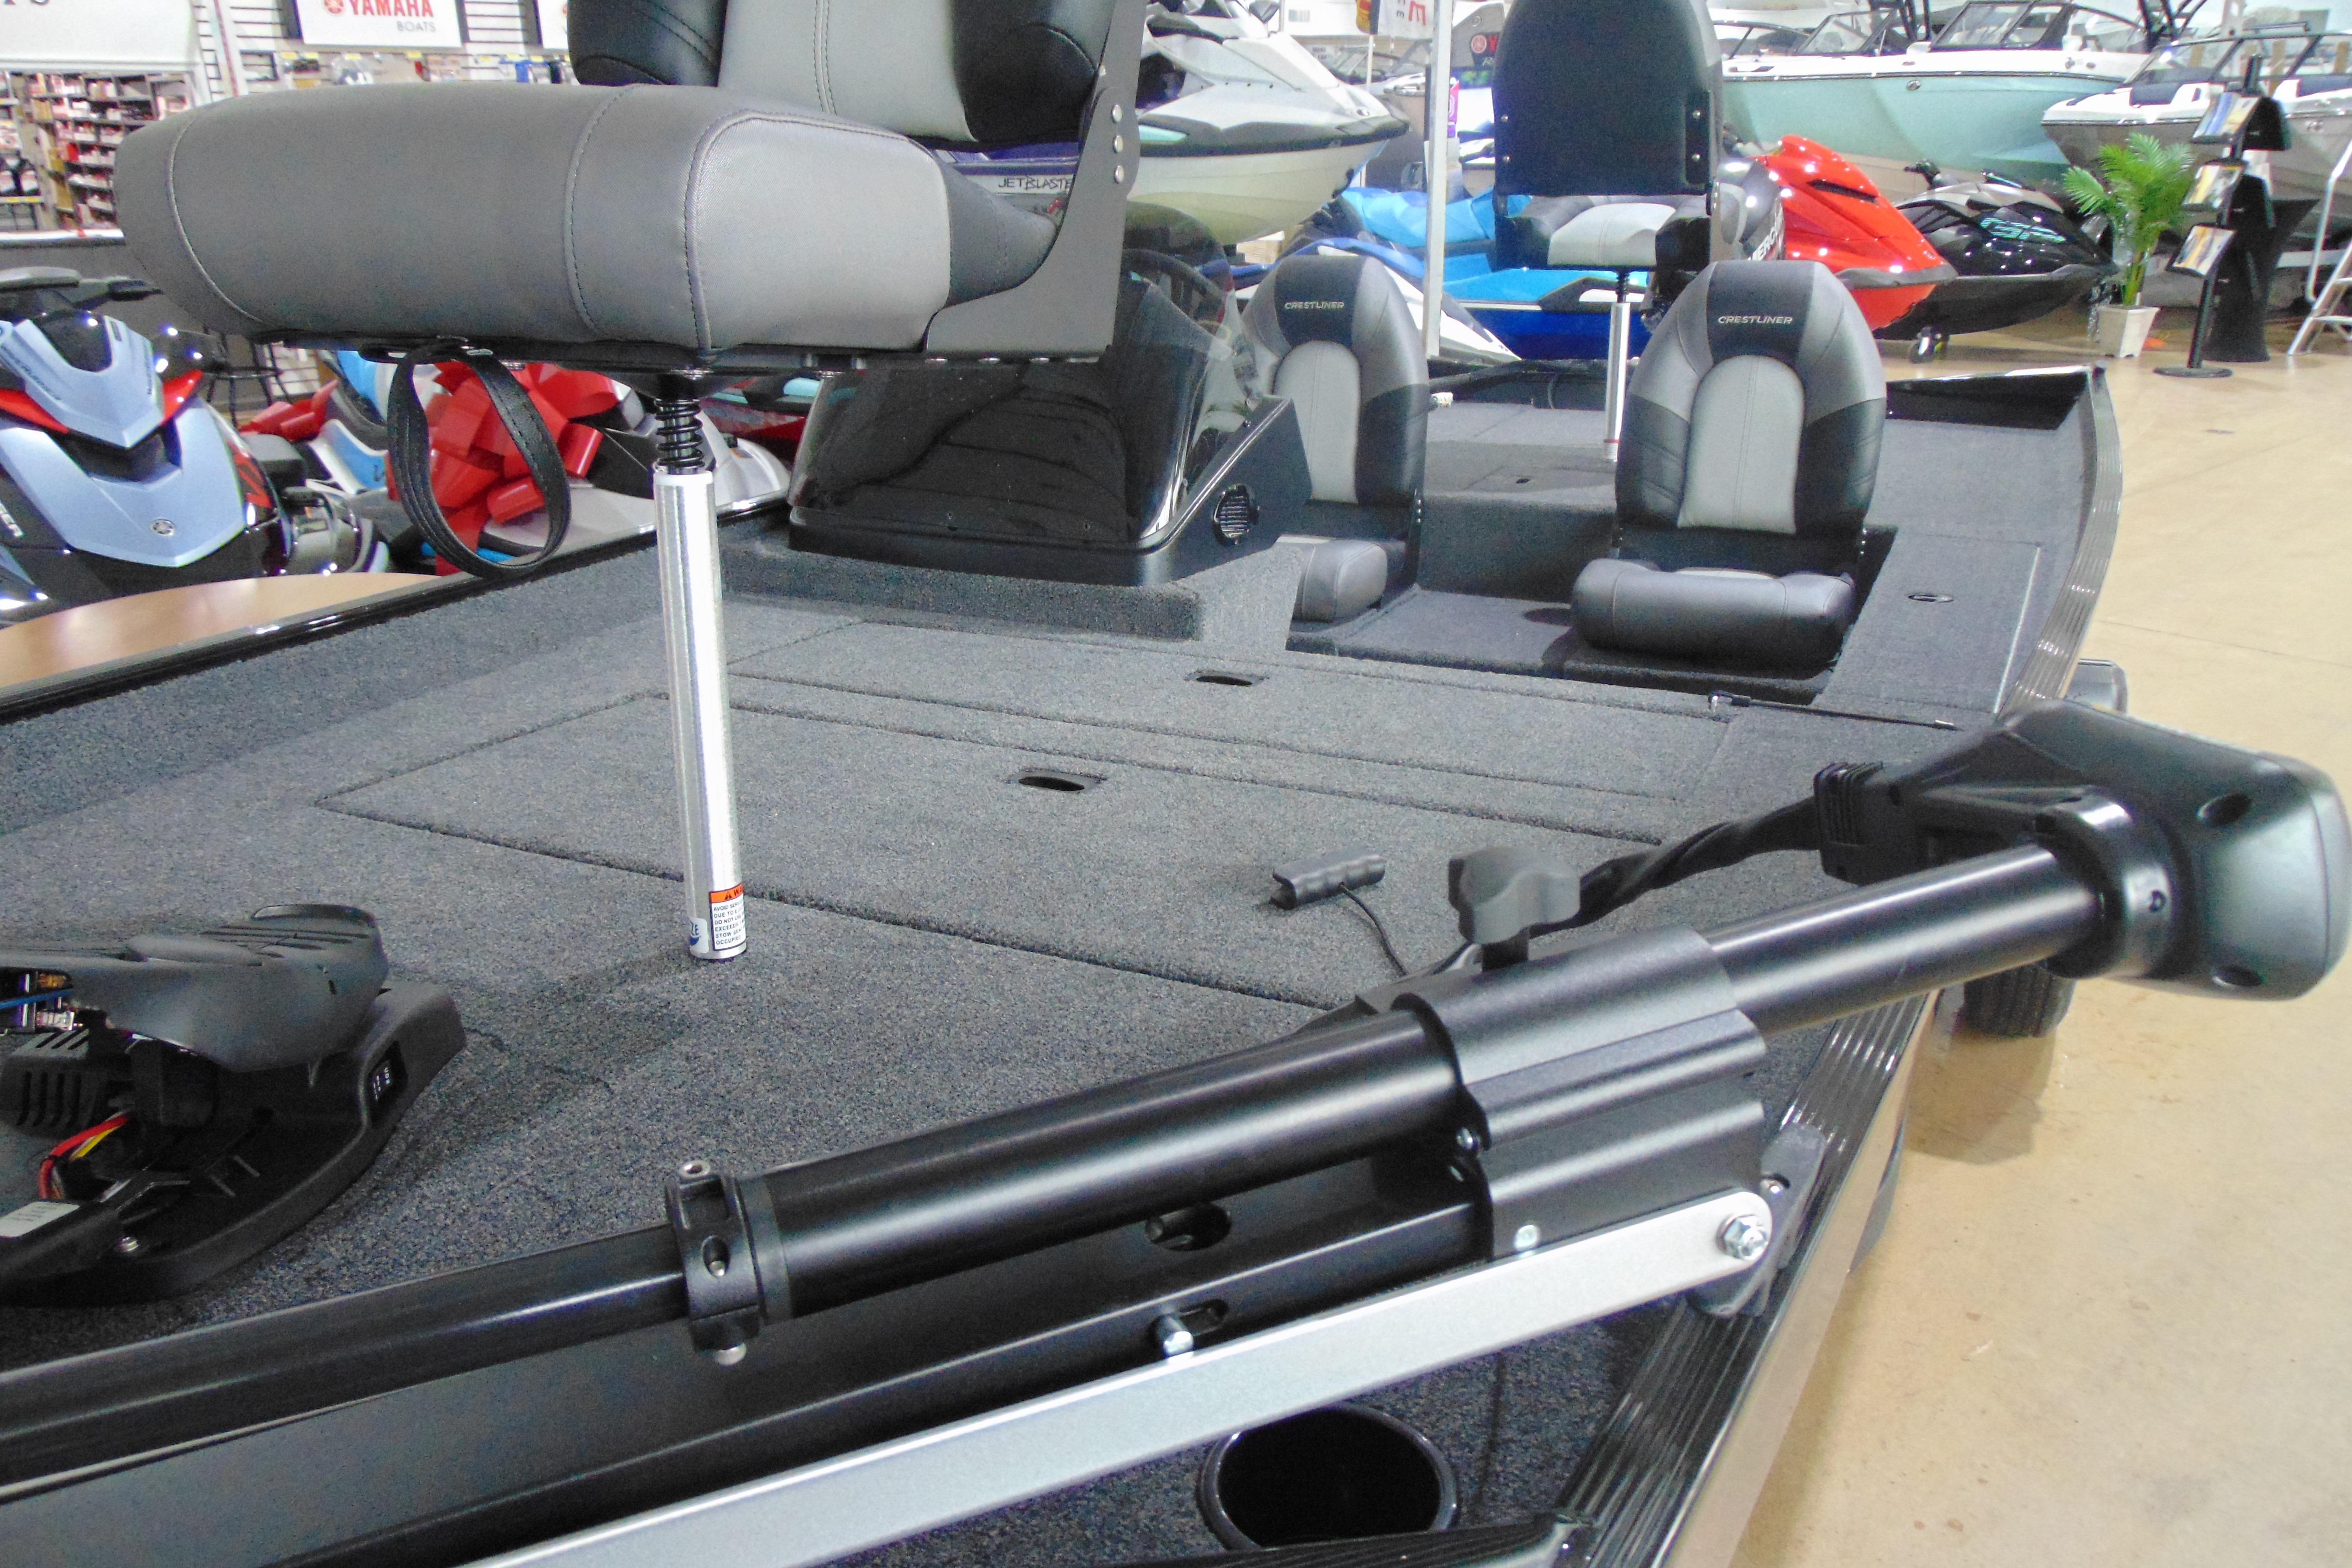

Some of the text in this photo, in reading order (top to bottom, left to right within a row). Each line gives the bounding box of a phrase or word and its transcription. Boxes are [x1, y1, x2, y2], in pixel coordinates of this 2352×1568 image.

[349, 0, 433, 17] YAMAHA
[397, 21, 436, 32] BOATS
[1284, 301, 1344, 309] CRESTLINER
[1718, 315, 1793, 325] CRESTLINER
[715, 923, 738, 932] EXCEEDS
